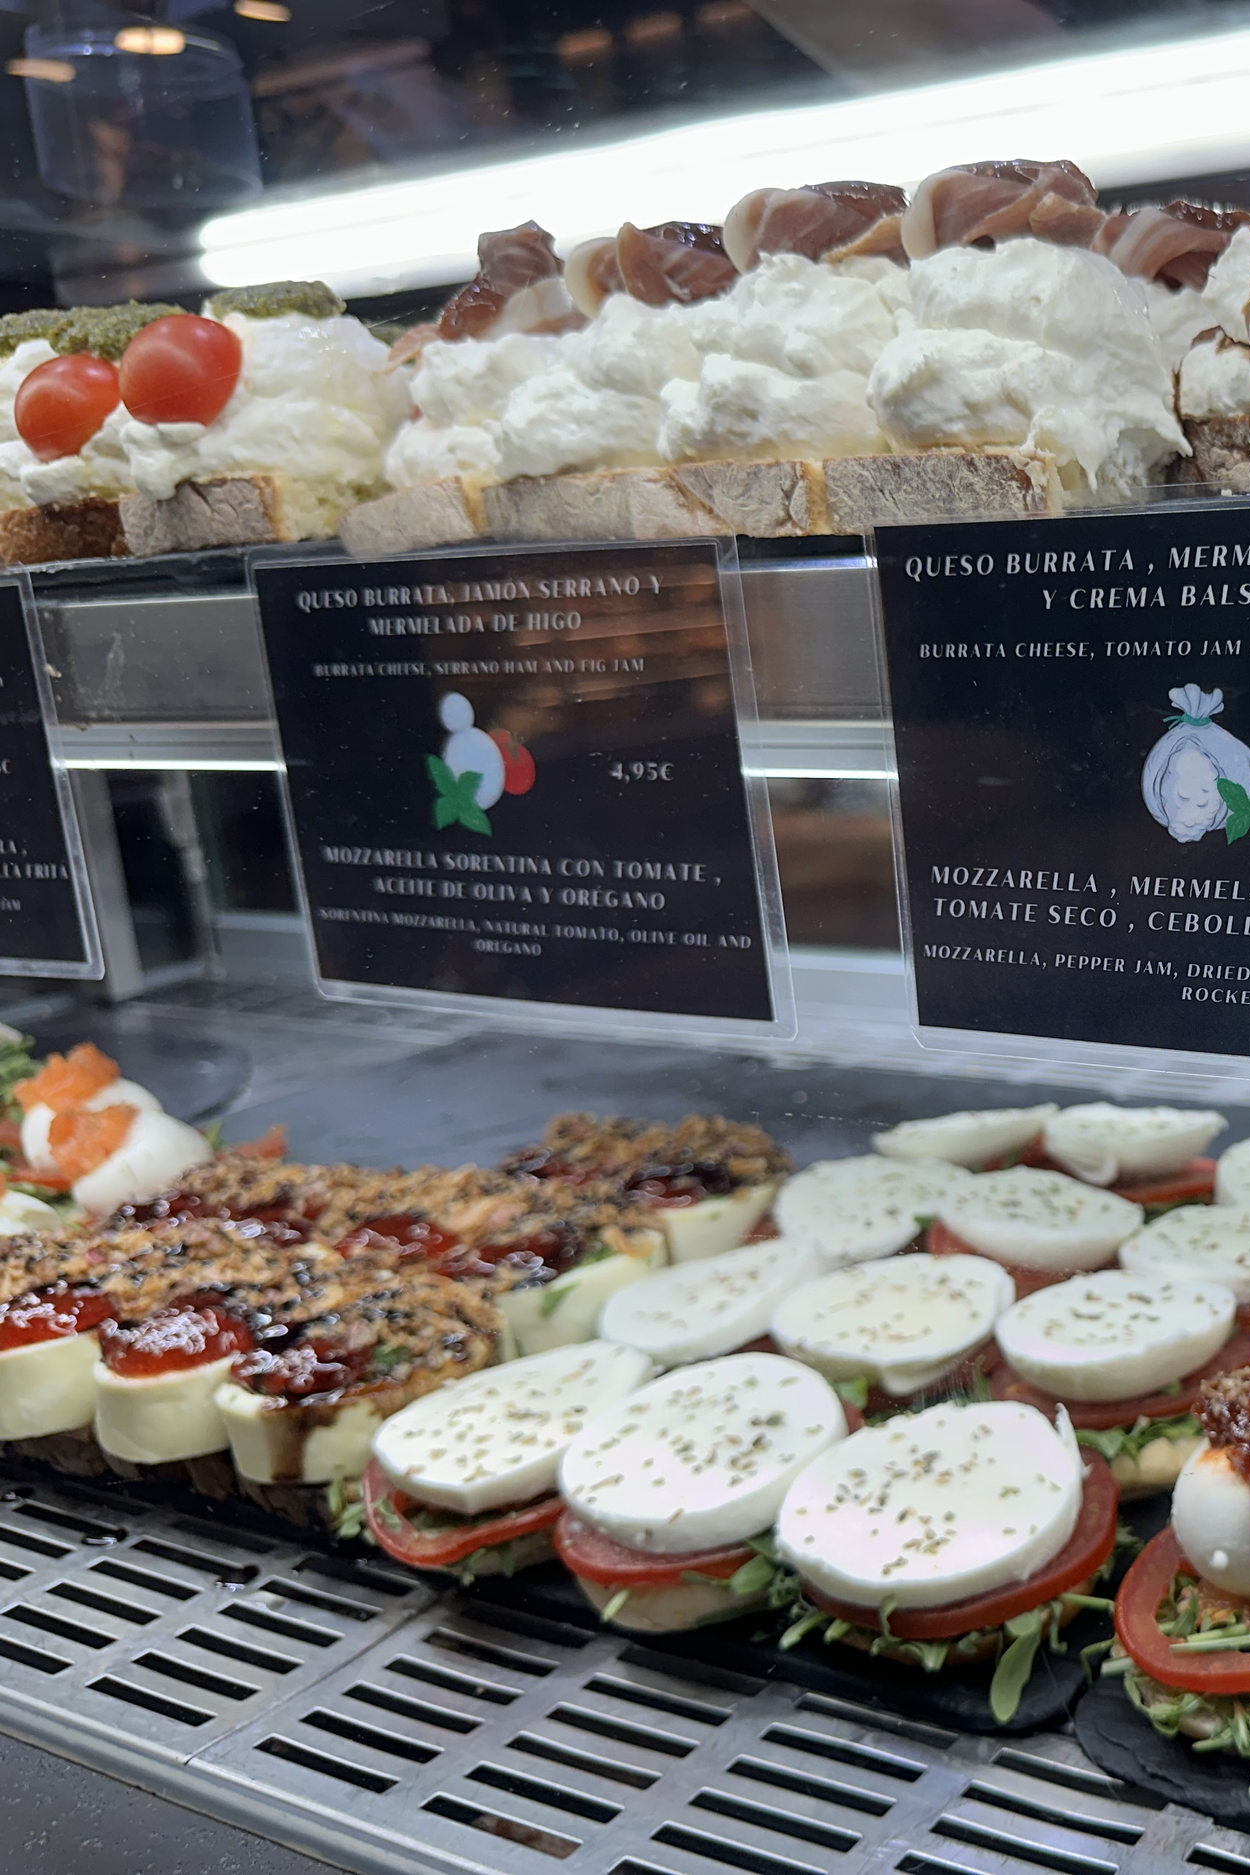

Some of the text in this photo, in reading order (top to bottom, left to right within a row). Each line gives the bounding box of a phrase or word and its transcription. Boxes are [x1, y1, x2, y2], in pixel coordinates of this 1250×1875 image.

[905, 554, 994, 582] QUESO
[1006, 549, 1134, 575] BURRATA
[298, 589, 358, 613] QUESO
[539, 575, 640, 599] SERRANO
[650, 574, 664, 595] Y
[1042, 589, 1057, 610] Y
[1069, 586, 1167, 610] CREMA
[368, 611, 581, 636] MERMELADA DE HIGO
[919, 643, 1006, 659] BURRATA
[1015, 642, 1095, 661] CHEESE,
[1105, 640, 1192, 658] TOMATO
[1200, 639, 1242, 656] JAM
[313, 663, 375, 678] BURRATA
[434, 660, 499, 675] SERRANO
[503, 660, 537, 674] HAM
[543, 659, 574, 674] AND
[580, 658, 606, 673] FIG
[612, 658, 645, 672] JAM
[609, 762, 675, 784] 4,95€
[321, 845, 438, 869] MOZZARELLA
[442, 853, 552, 876] SORENTINA
[558, 858, 604, 877] CON
[612, 859, 707, 882] TOMATE
[372, 875, 436, 898] ACEITE
[440, 880, 467, 900] DE
[470, 882, 532, 903] OLIVA
[536, 886, 553, 904] Y
[931, 865, 1098, 893] MOZZARELLA
[934, 898, 1038, 923] TOMATE
[1048, 905, 1117, 928] SECO
[629, 929, 677, 946] OLIVE
[682, 932, 711, 948] OIL
[718, 935, 751, 949] AND
[923, 944, 1047, 970] MOZZARELLA,
[1055, 953, 1125, 973] PEPPER
[1133, 959, 1178, 979] JAM,
[1187, 963, 1250, 982] DRIED
